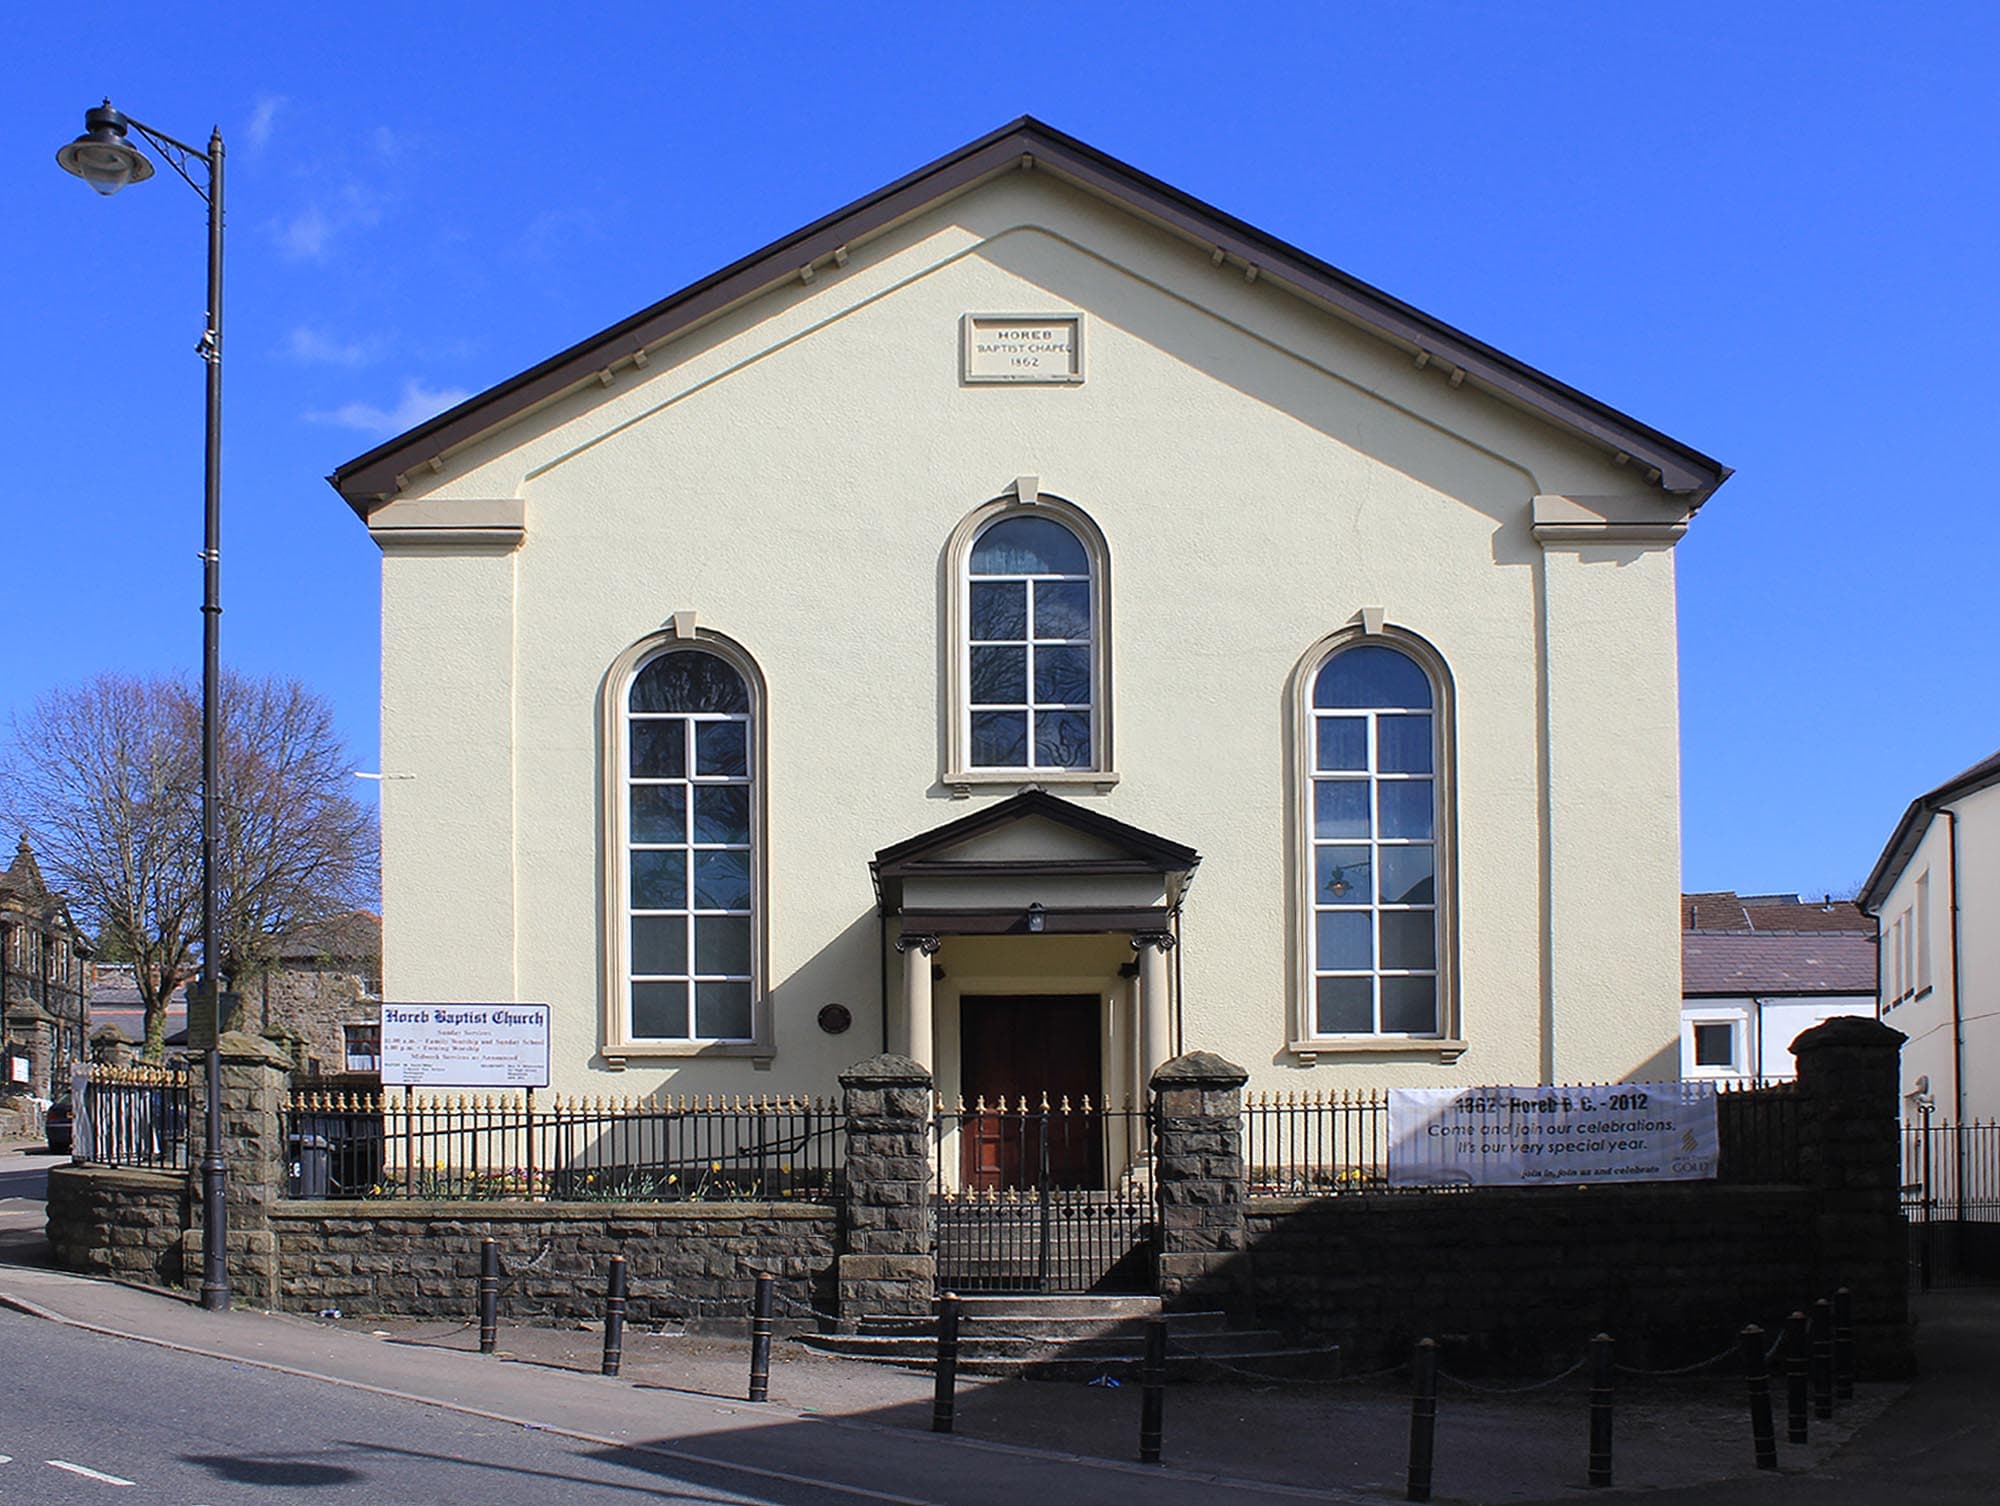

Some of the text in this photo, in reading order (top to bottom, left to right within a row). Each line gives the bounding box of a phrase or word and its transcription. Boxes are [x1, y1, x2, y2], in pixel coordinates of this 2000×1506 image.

[998, 330, 1052, 340] HOREB
[977, 344, 1024, 353] BAPTIST
[1010, 357, 1040, 367] 1862
[385, 1009, 543, 1027] Horeb Baptist Church
[1509, 1097, 1556, 1114] Horeb
[1609, 1094, 1648, 1111] 2012
[1428, 1119, 1677, 1138] Come and join our celebrations.
[1481, 1143, 1507, 1154] our
[1510, 1143, 1543, 1156] very
[1548, 1139, 1605, 1156] special
[1608, 1139, 1648, 1153] year.
[1594, 1167, 1612, 1175] and
[1614, 1165, 1660, 1174] celebrate
